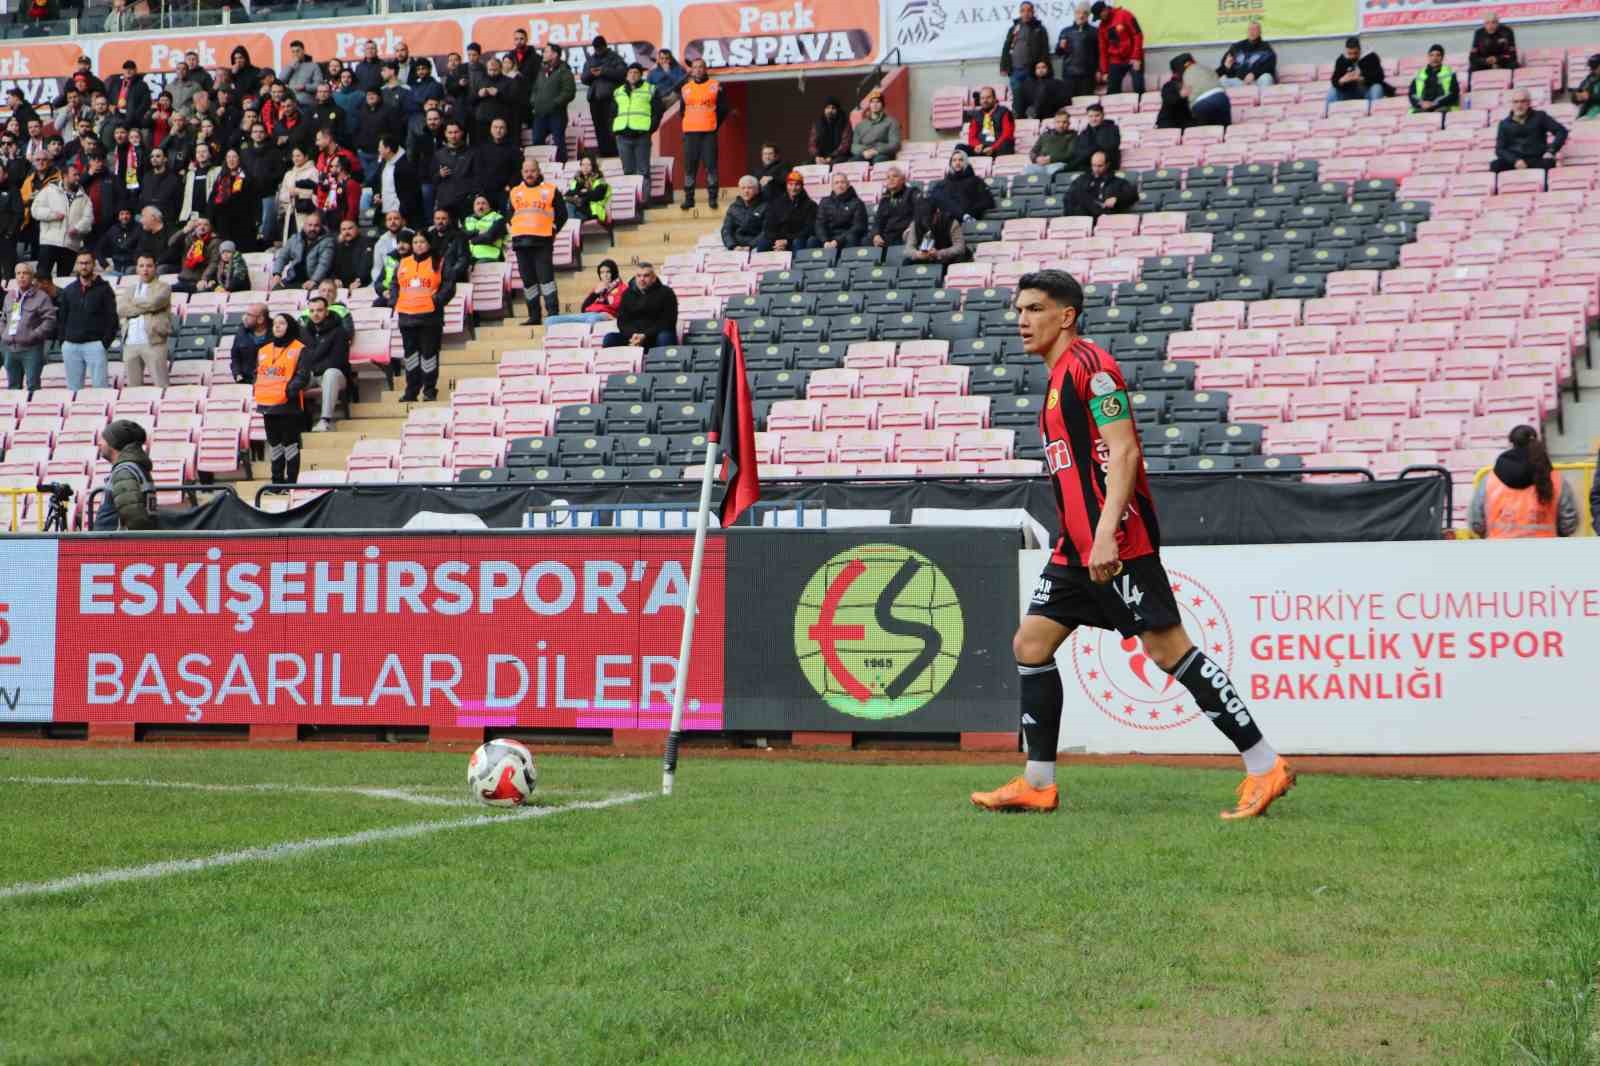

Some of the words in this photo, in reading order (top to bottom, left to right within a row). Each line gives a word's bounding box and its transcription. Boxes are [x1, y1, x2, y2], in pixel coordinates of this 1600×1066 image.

[529, 14, 600, 43] Park
[739, 3, 814, 33] Park
[150, 40, 216, 68] Pak
[702, 32, 856, 68] ASPAVA
[80, 546, 700, 632] ESKİŞEHİRSPOR'A
[1250, 590, 1385, 622] TÜRKİYE
[1396, 585, 1600, 620] CUMHURİYE
[1250, 628, 1402, 668] GENÇLİK
[1412, 631, 1457, 660] VE
[1468, 630, 1565, 659] SPOR
[87, 652, 464, 721] BAŞARILAR
[486, 640, 701, 711] DİLER.
[1250, 667, 1443, 700] BAKANLIĞI
